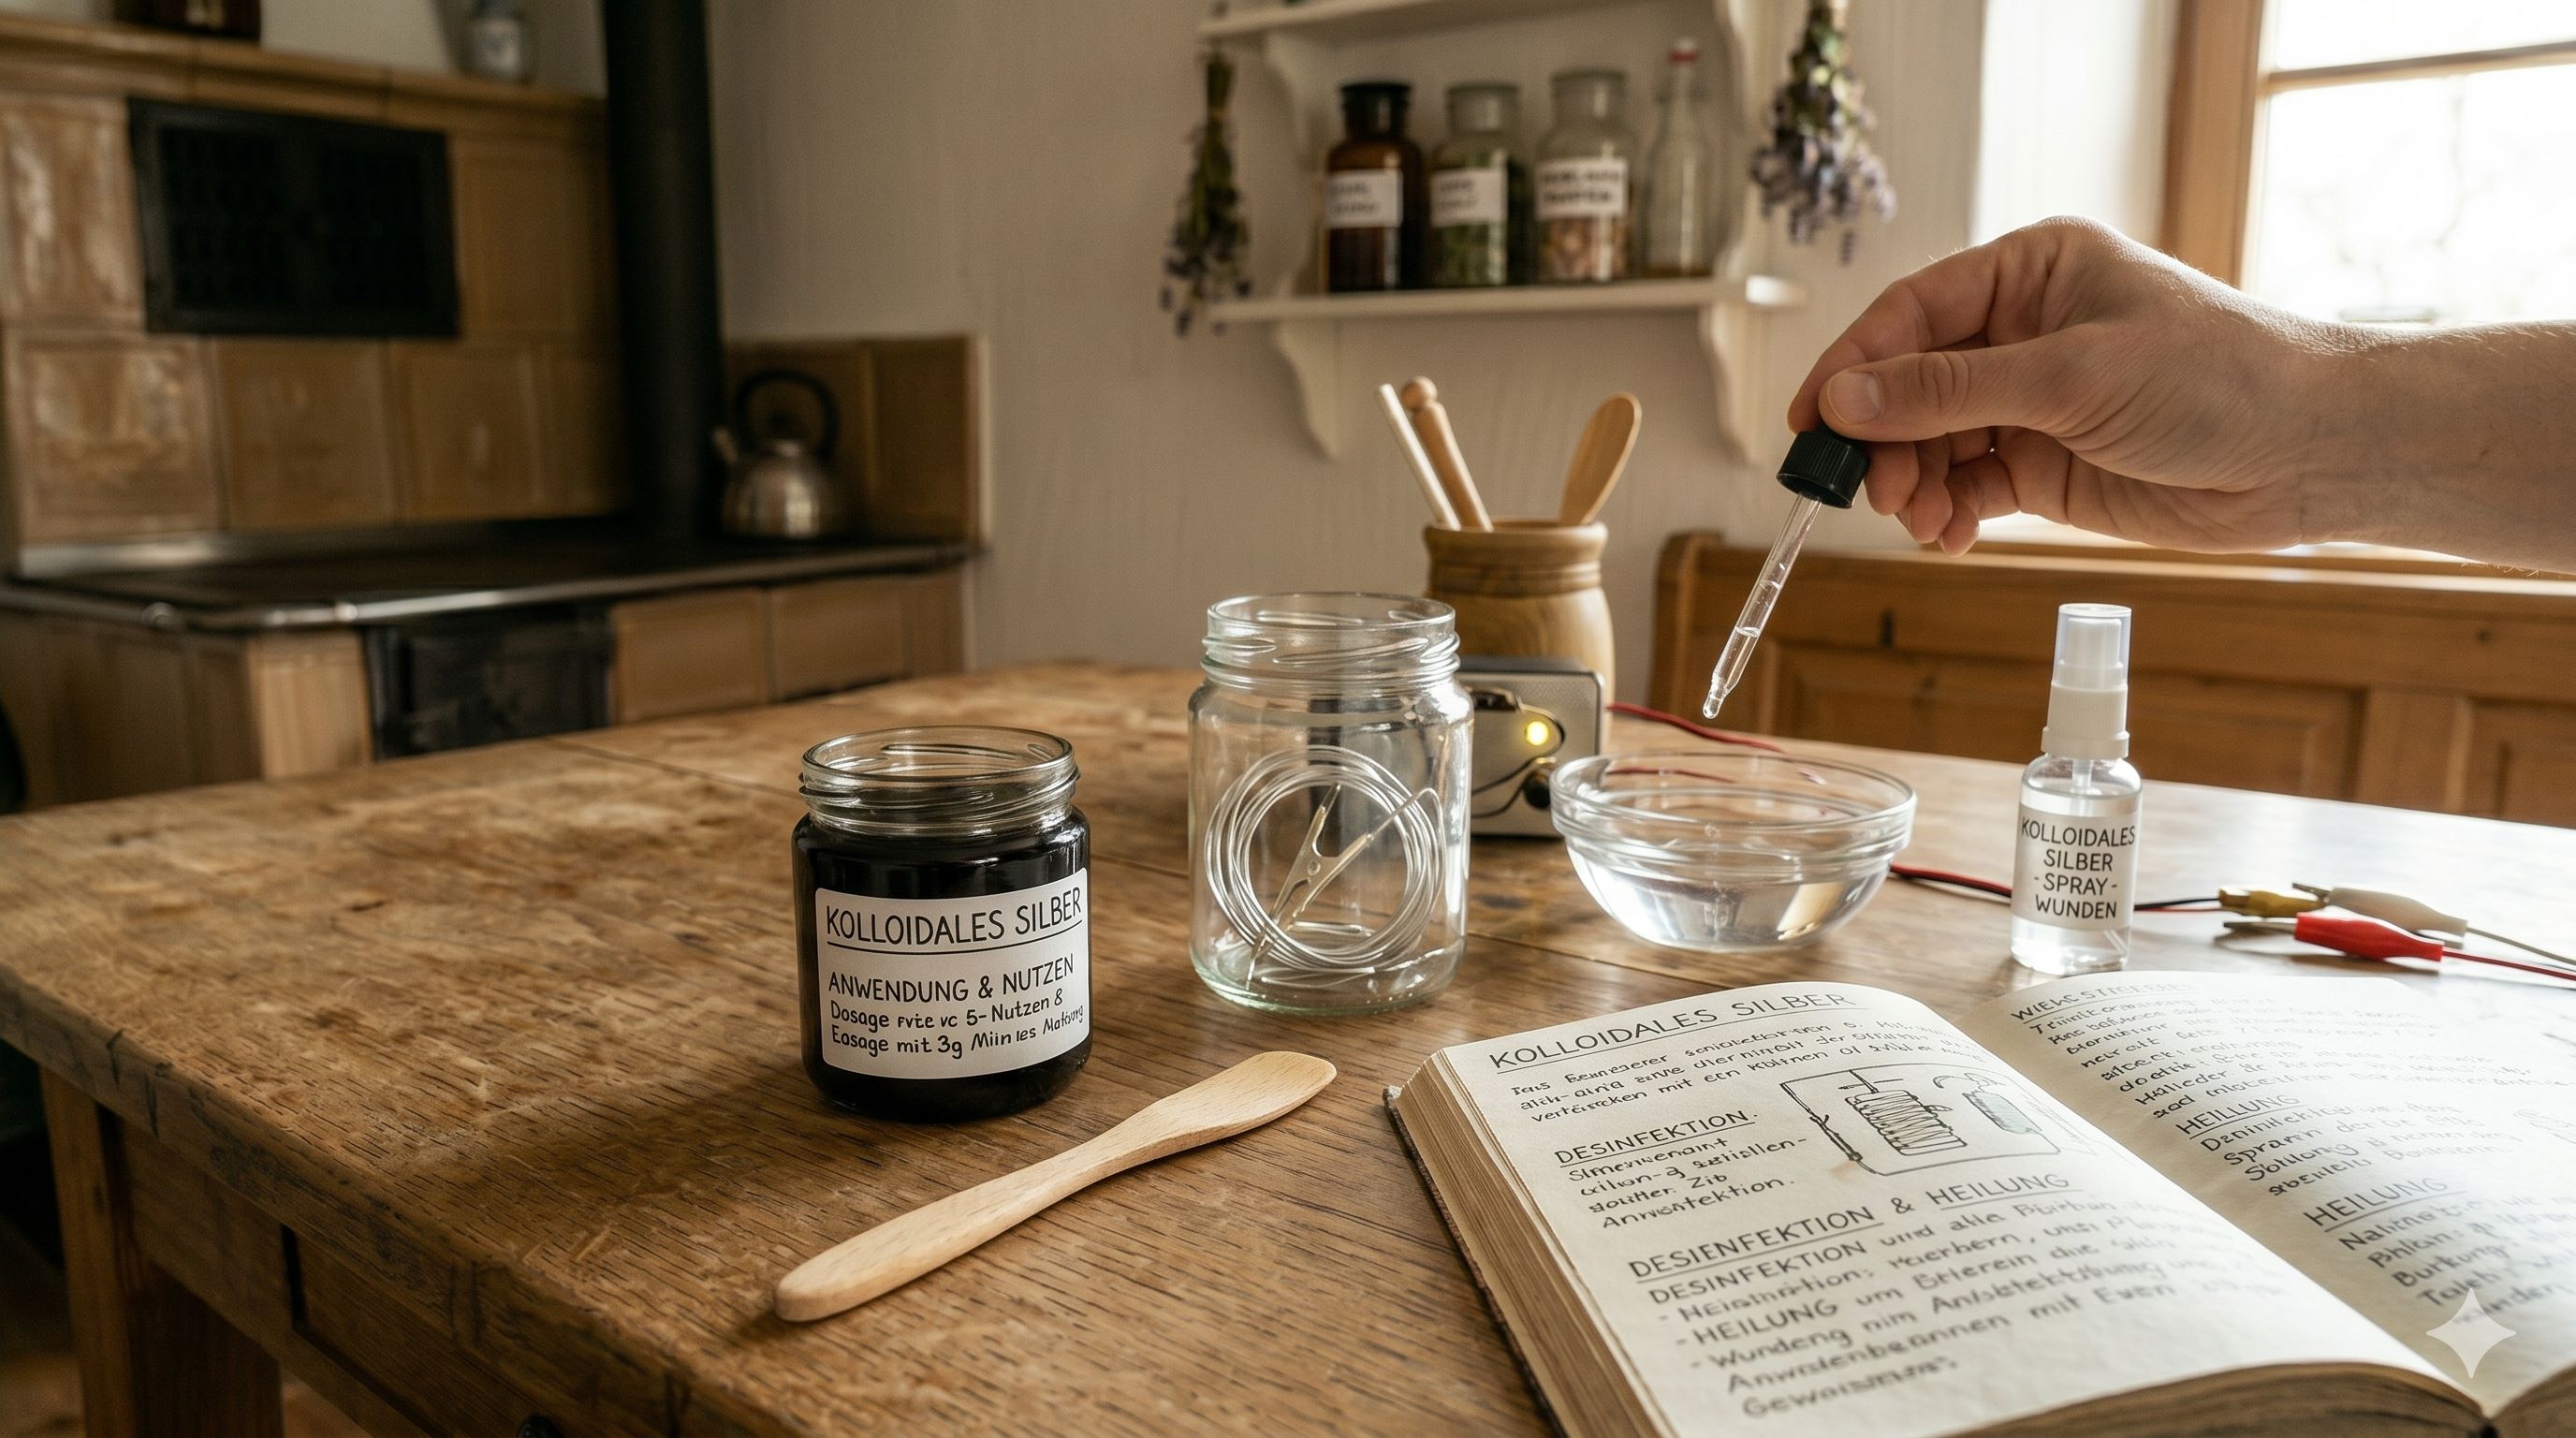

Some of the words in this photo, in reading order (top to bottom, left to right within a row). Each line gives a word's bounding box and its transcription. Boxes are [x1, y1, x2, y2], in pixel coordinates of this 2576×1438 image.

[2021, 816, 2135, 847] KOLLOIDALES
[2043, 848, 2114, 872] SILBER
[827, 904, 1004, 946] KOLLOIDALES
[1015, 887, 1082, 934] SILBER
[2035, 894, 2117, 919] WUNDEN
[828, 971, 969, 1003] ANWENDUNG
[977, 976, 993, 999] &
[1003, 953, 1074, 994] NUTZEN
[830, 999, 889, 1034] Dosage
[1489, 1008, 1718, 1069] KOLLOIDALES
[1731, 992, 1857, 1018] SILBER
[897, 1037, 932, 1053] mit
[937, 1034, 963, 1060] 3g
[1658, 1078, 1693, 1093] mit
[1628, 1206, 1876, 1278] DESIENFEKTION
[1891, 1197, 1915, 1215] &
[1925, 1173, 2070, 1205] HEILUNG
[2303, 1177, 2449, 1227] HEILUNG
[1648, 1240, 1867, 1304] DESINFEKTION
[1691, 1298, 1839, 1346] HEILUNG
